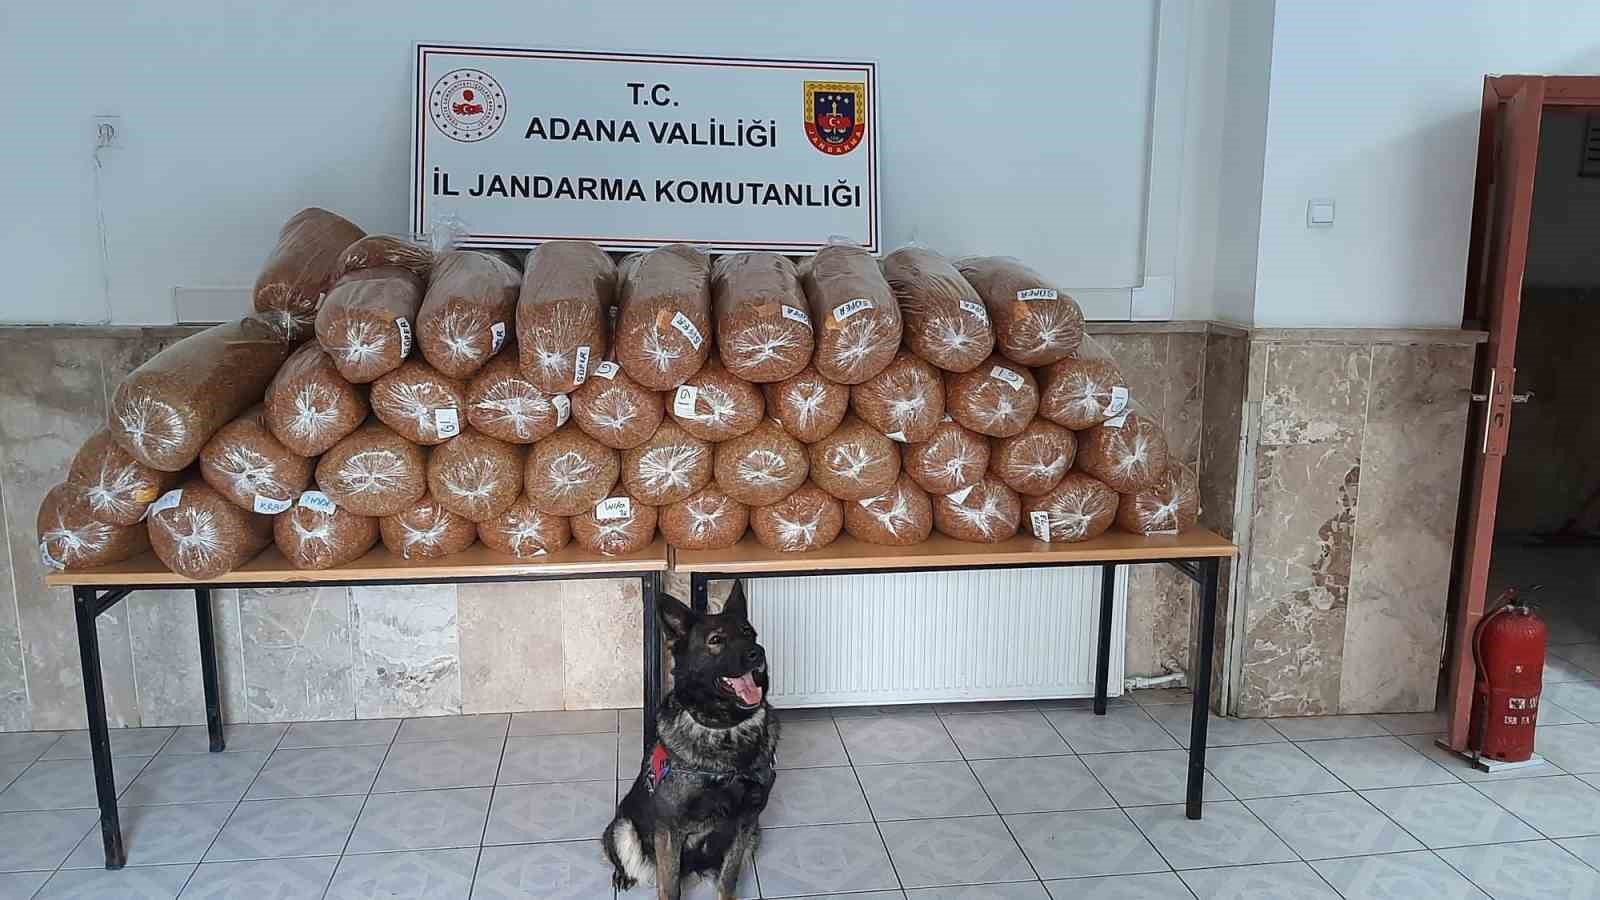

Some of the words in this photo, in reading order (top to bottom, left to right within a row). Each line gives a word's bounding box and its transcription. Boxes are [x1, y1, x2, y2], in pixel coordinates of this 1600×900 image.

[627, 82, 679, 107] T.C.
[525, 116, 641, 144] ADANA
[648, 117, 777, 148] VALİLİĞİ
[433, 166, 460, 196] İL
[468, 173, 647, 202] JANDARMA
[655, 178, 861, 208] KOMUTANLIĞI
